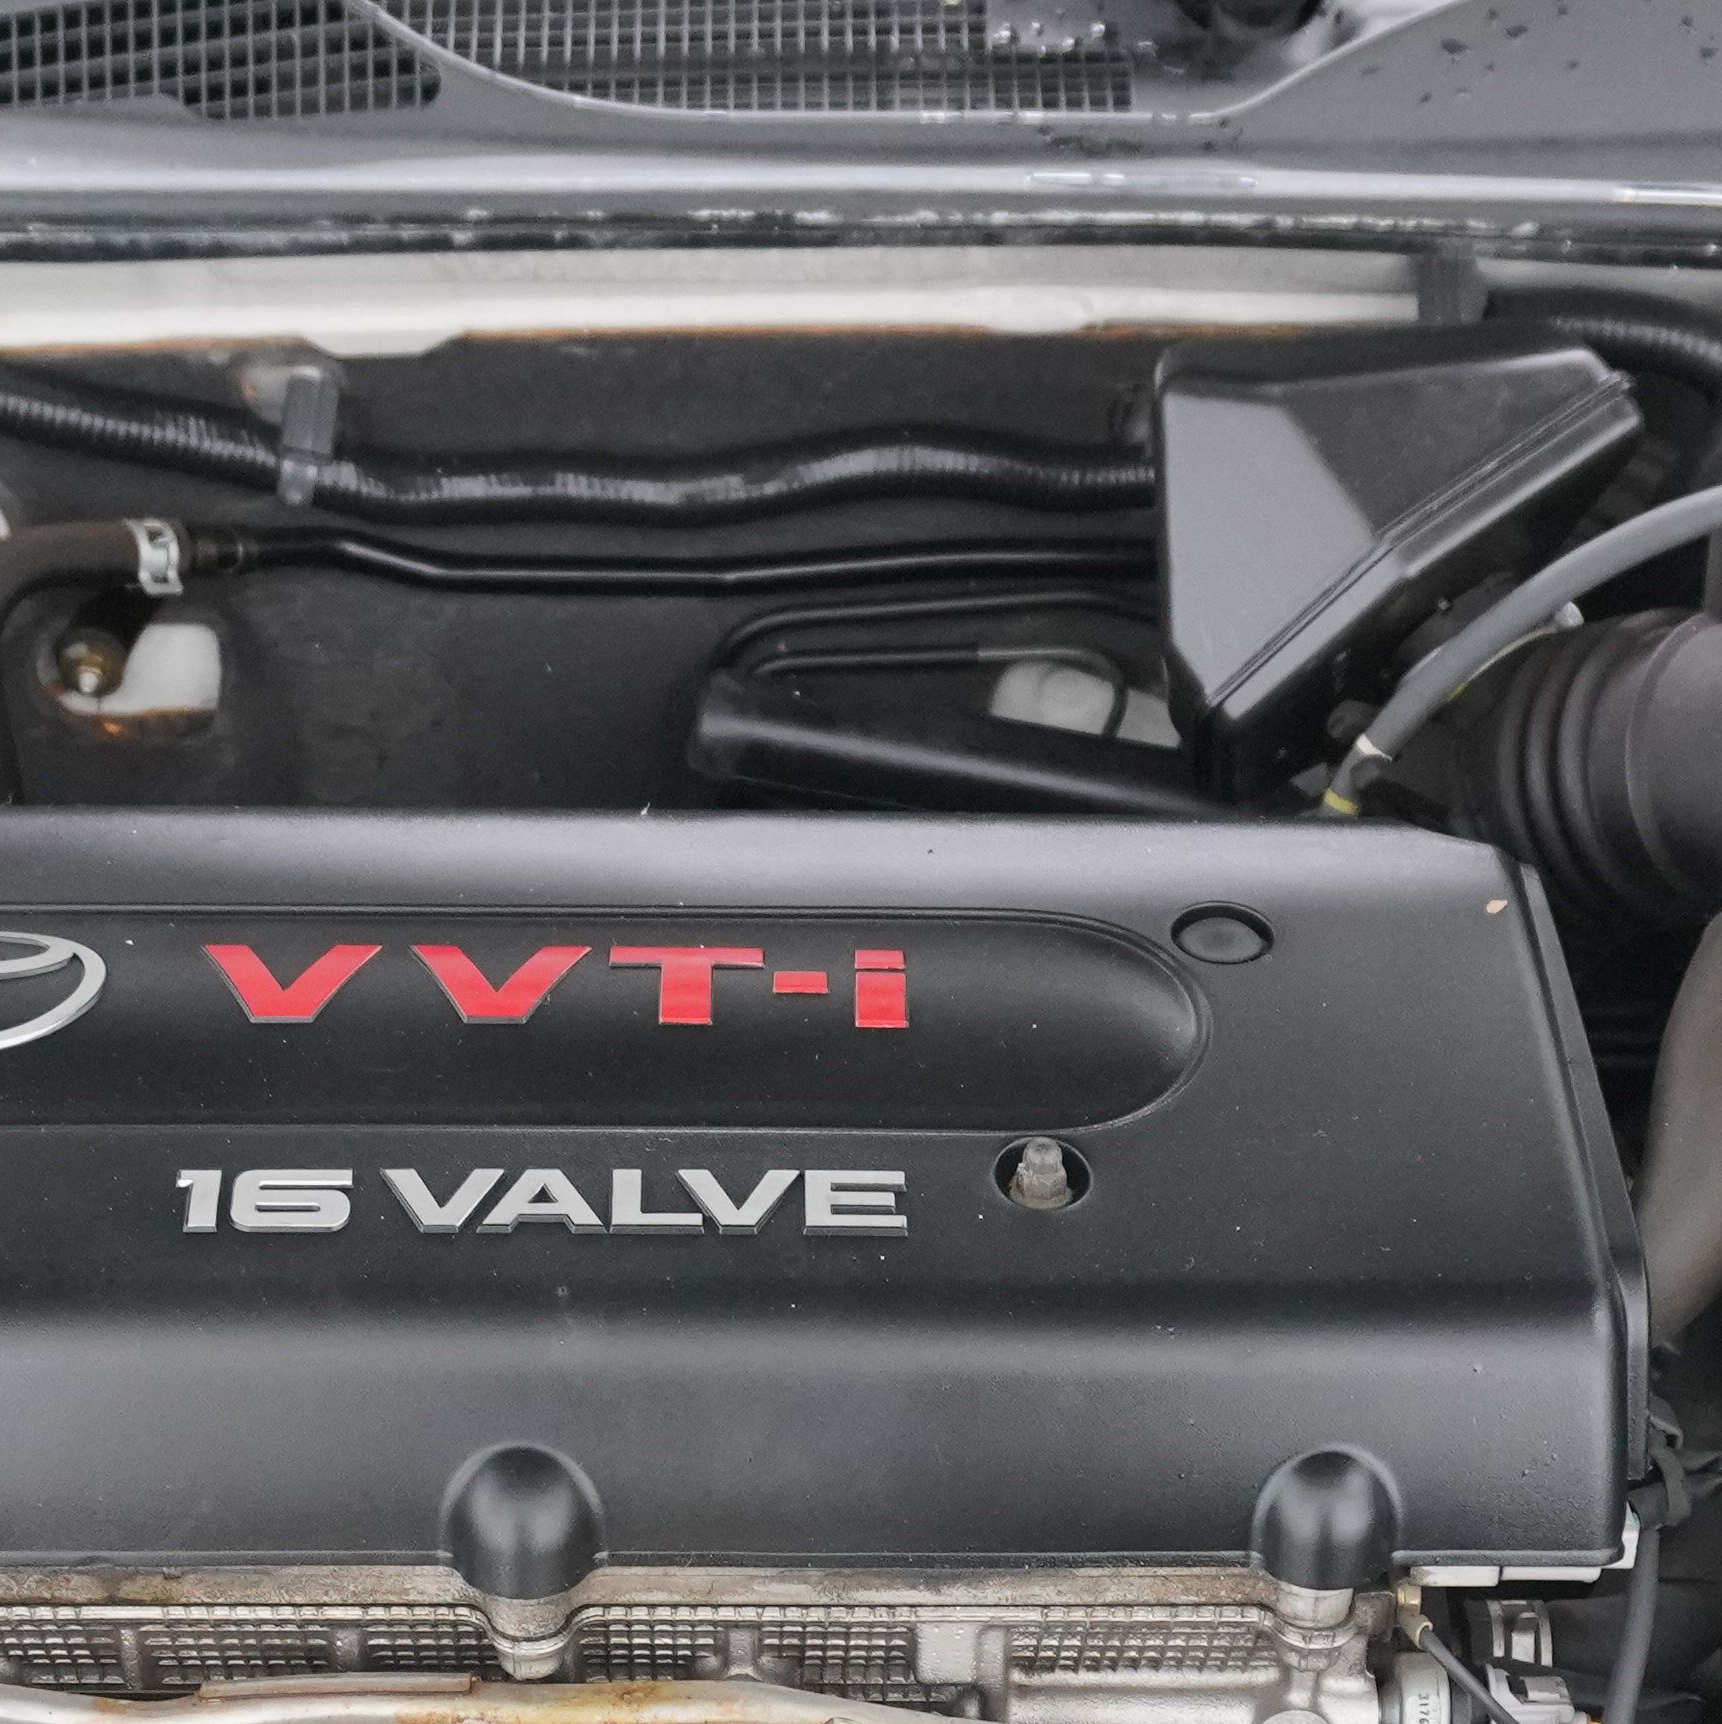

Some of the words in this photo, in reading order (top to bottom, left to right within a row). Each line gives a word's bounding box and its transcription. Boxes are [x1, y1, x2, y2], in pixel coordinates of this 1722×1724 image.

[202, 945, 909, 1028] VVT-i
[175, 1168, 353, 1234] 16
[379, 1168, 908, 1237] VALVE
